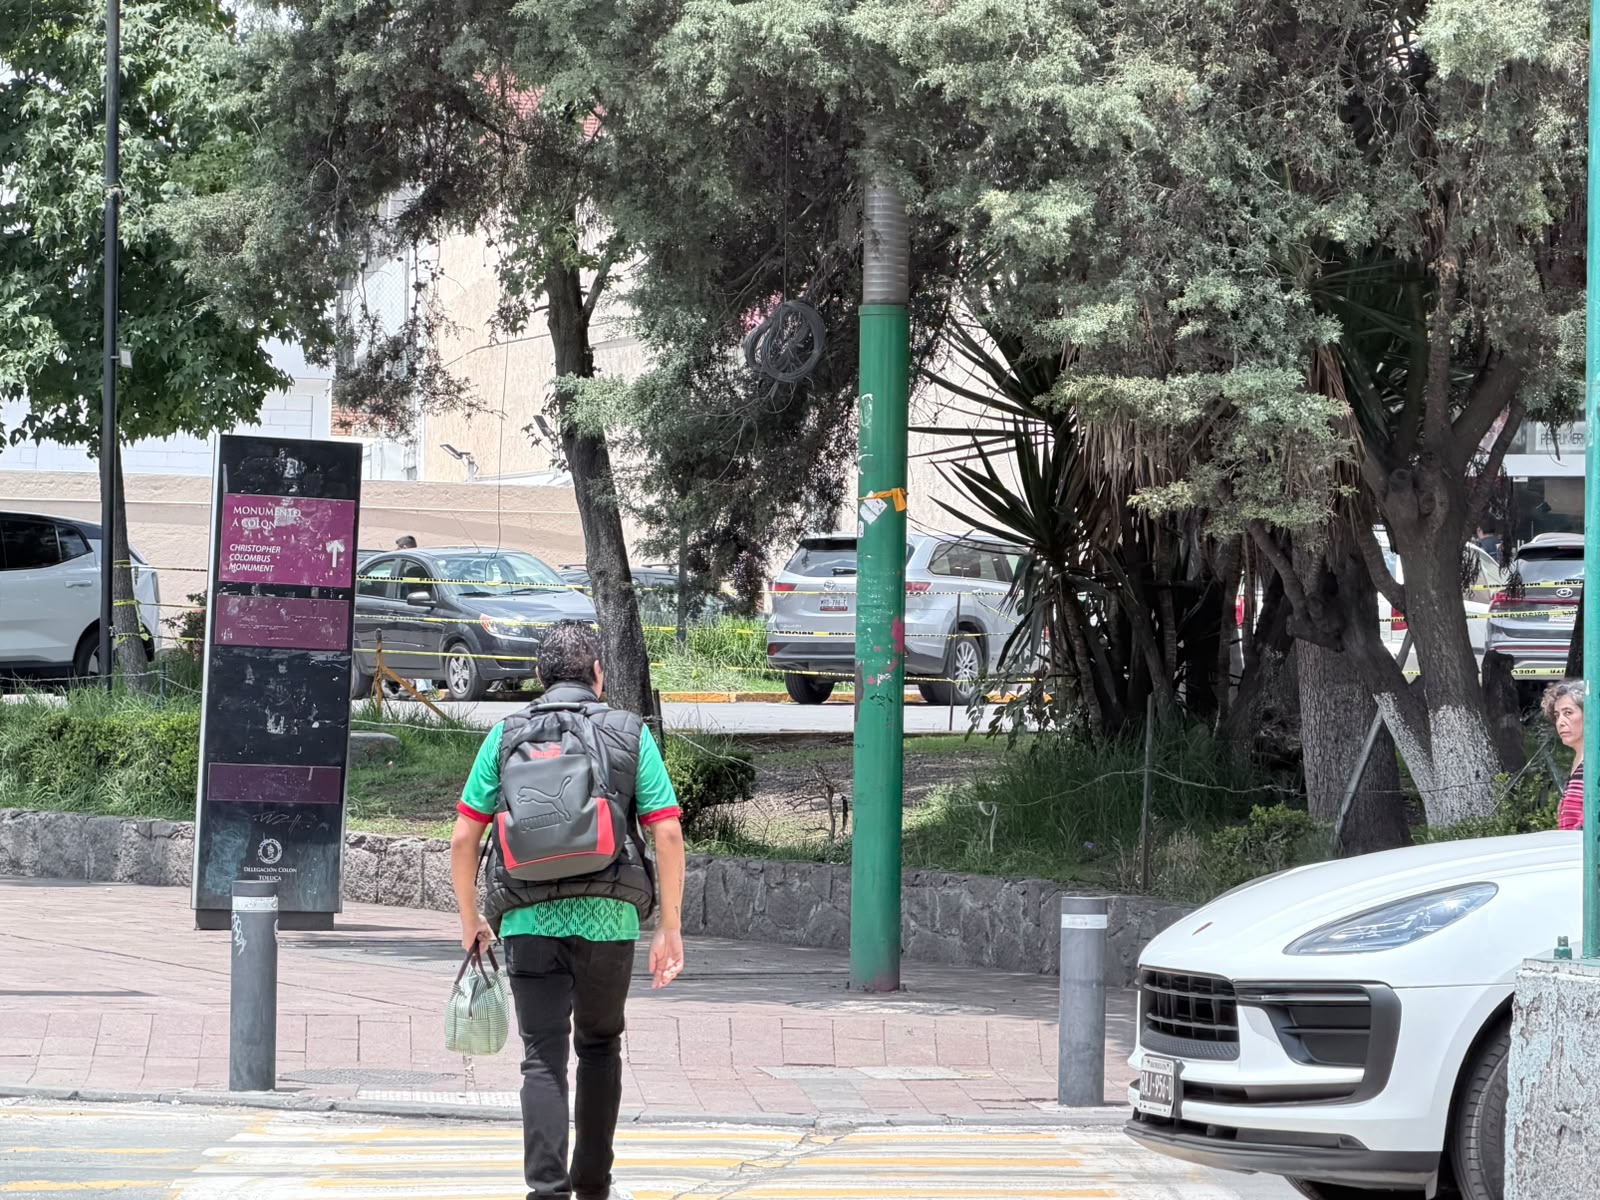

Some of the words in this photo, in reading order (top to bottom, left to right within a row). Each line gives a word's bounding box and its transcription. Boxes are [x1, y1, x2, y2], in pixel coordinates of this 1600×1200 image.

[231, 518, 239, 527] A
[229, 543, 281, 554] CHRISTOPHER
[229, 553, 271, 563] COLOMBUS
[229, 562, 275, 572] MONUMENT
